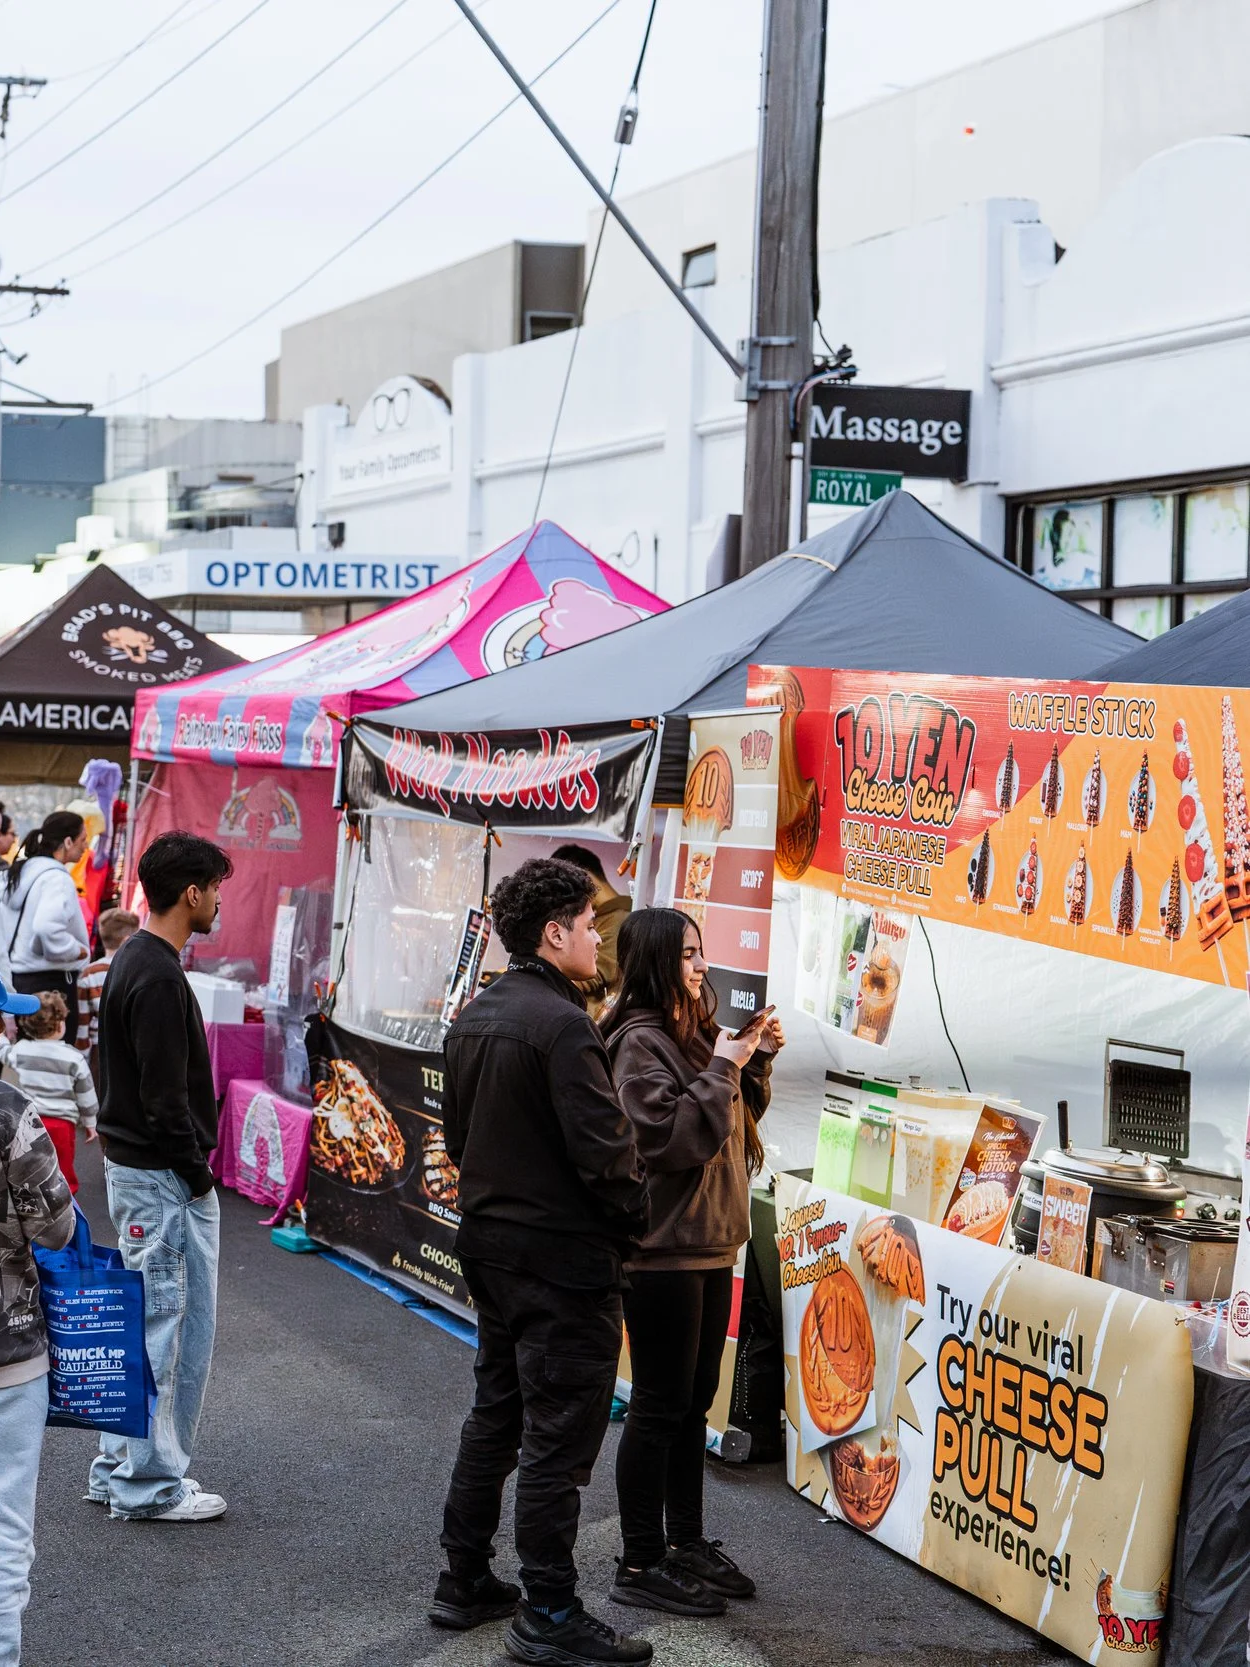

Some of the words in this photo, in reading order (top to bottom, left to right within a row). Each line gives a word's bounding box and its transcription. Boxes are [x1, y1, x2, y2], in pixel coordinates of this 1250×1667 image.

[810, 405, 962, 456] Massage
[815, 479, 875, 504] ROYAL
[206, 561, 440, 589] OPTOMETRIST
[61, 603, 113, 643] BRAD'S
[119, 603, 152, 622] PIT
[156, 621, 194, 650] BBQ
[69, 649, 157, 683] SMOKED
[219, 714, 250, 752] Fairy
[249, 715, 282, 754] Floss
[1010, 692, 1088, 733] WAFFLE
[1091, 698, 1156, 740] STICK
[835, 694, 884, 794] 10
[888, 691, 976, 806] YEN
[451, 728, 601, 814] Noodles
[846, 766, 906, 818] Cheese
[910, 775, 956, 827] Coin
[841, 820, 876, 852] VIRAL
[877, 826, 946, 866] JAPANESE
[845, 853, 897, 890] CHEESE
[897, 863, 933, 898] PULL
[976, 1150, 1011, 1162] CHEESY
[977, 1161, 1017, 1173] HOTDOG
[428, 1201, 443, 1217] BBQ
[781, 1199, 826, 1235] Japanese
[402, 1259, 424, 1280] Freshly
[424, 1270, 455, 1295] Wok-Fried
[783, 1258, 821, 1291] Cheese
[821, 1248, 842, 1278] Coin
[936, 1283, 973, 1337] Try
[978, 1310, 1020, 1349] our
[1026, 1319, 1084, 1375] viral
[1234, 1312, 1250, 1320] SELLE
[59, 1360, 123, 1372] CAULFIELD
[108, 1349, 125, 1359] MP
[937, 1333, 1108, 1480] CHEESE
[933, 1407, 1038, 1533] PULL
[930, 1490, 1071, 1592] experience!
[1098, 1614, 1124, 1642] 10
[1106, 1635, 1147, 1653] Cheese
